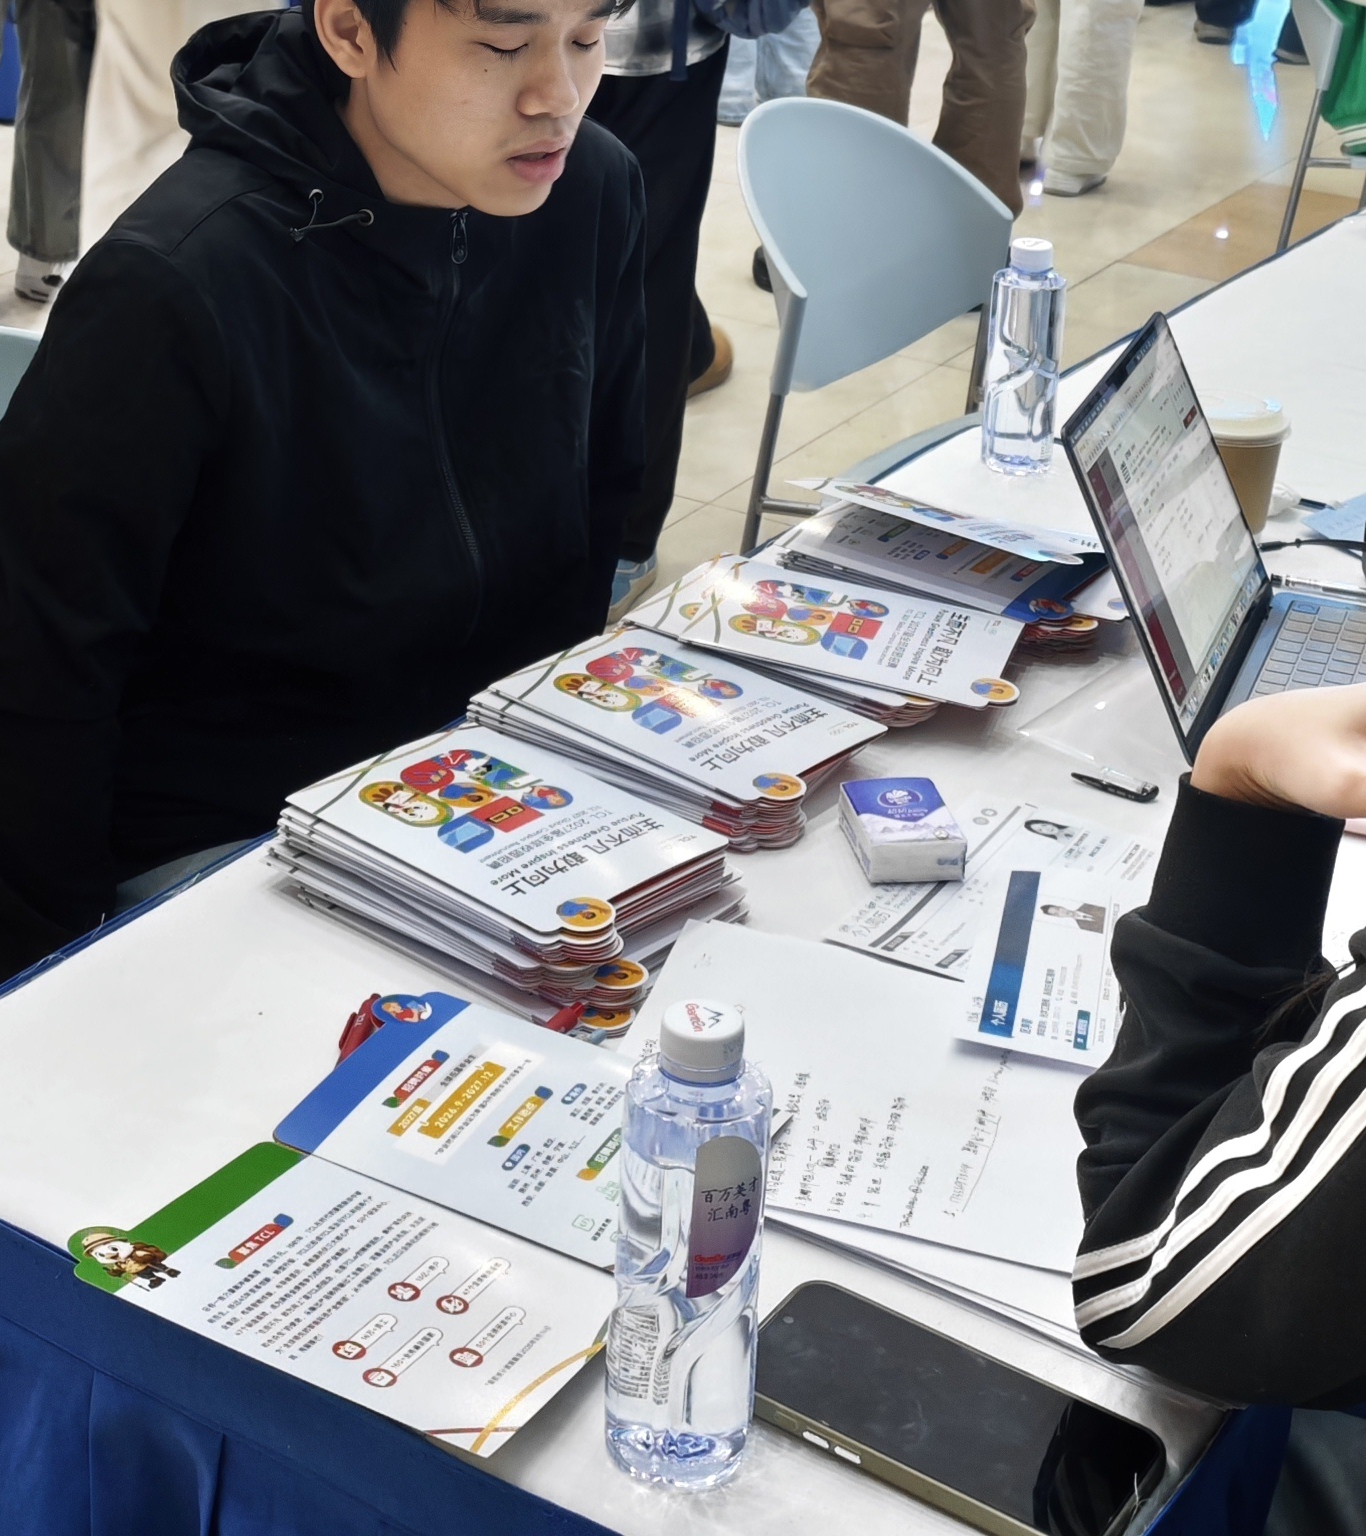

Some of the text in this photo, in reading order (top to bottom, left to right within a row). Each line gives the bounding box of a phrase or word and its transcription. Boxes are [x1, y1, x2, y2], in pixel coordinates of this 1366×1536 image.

[490, 868, 522, 886] More
[434, 1070, 495, 1129] 2026.9-2027.12
[701, 1176, 759, 1203] 百万英才
[707, 1198, 752, 1222] 汇南粤
[257, 1229, 276, 1244] TCL
